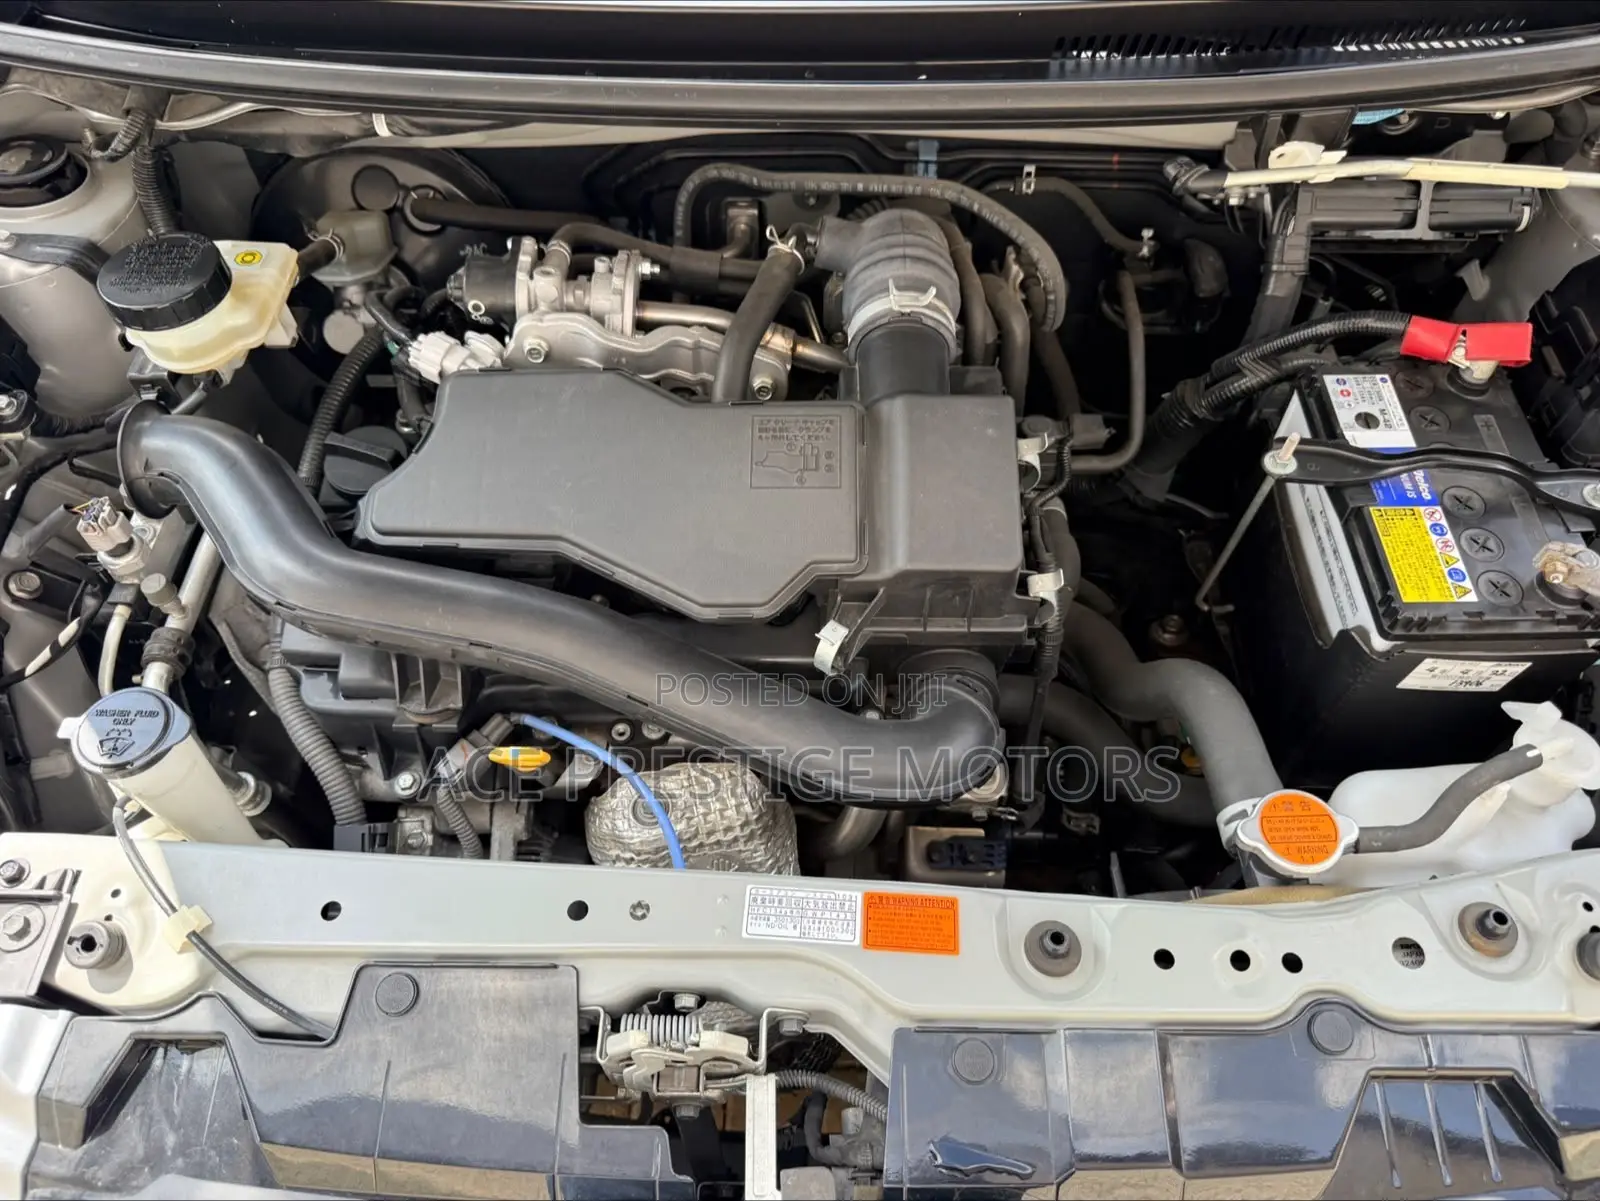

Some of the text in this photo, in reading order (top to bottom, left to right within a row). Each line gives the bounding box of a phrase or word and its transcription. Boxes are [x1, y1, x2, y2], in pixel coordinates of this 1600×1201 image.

[95, 709, 160, 718] WASHER FLUID
[112, 718, 136, 726] ONLY
